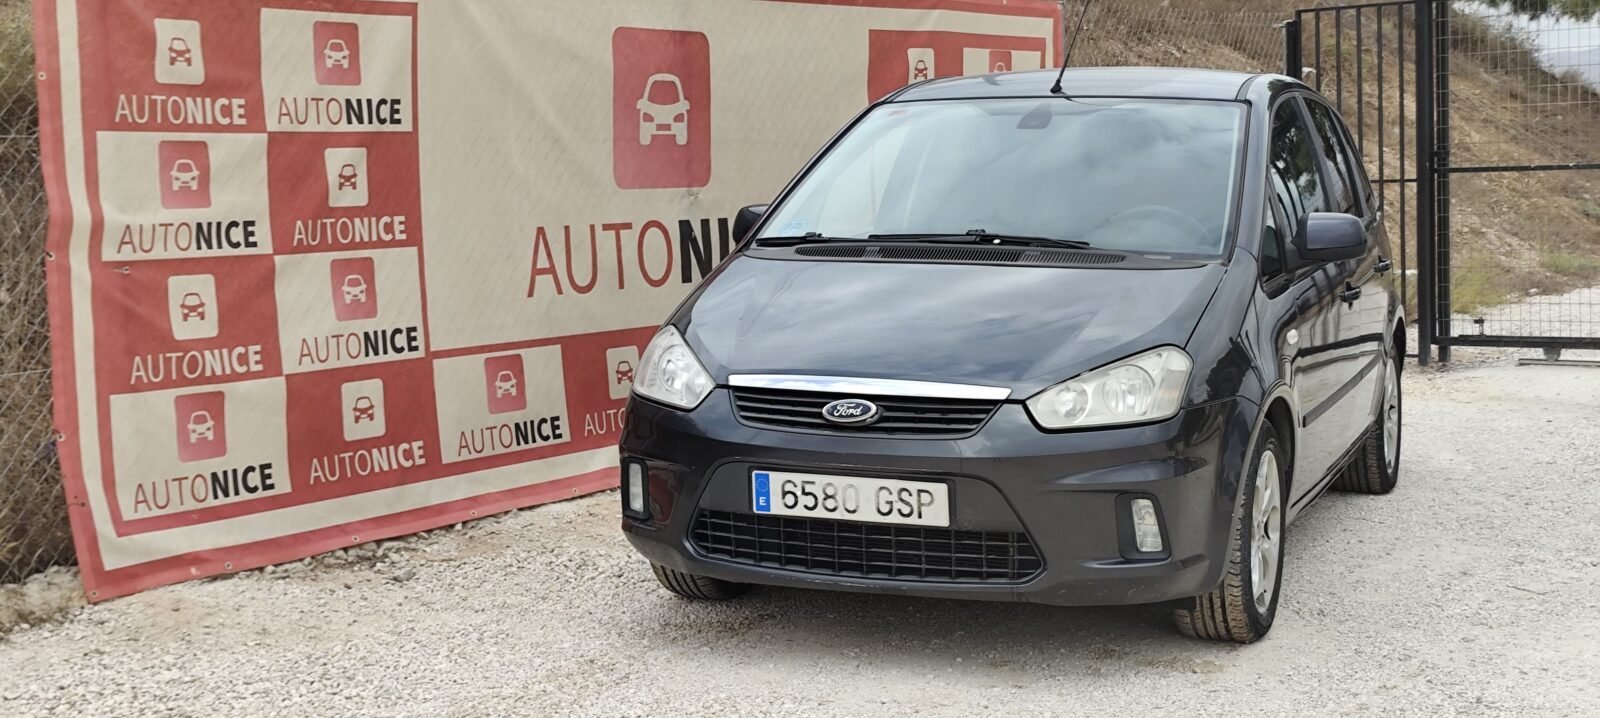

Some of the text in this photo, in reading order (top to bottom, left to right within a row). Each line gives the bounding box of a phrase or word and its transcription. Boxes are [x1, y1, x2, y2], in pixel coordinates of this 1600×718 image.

[115, 94, 247, 125] AUTONICE
[278, 97, 402, 125] AUTONICE
[117, 220, 258, 254] AUTONICE
[293, 215, 407, 246] AUTONICE
[527, 217, 730, 298] AUTONI
[131, 345, 263, 385] AUTONICE
[298, 326, 419, 366] AUTONICE
[833, 403, 863, 416] Ford
[458, 416, 563, 457] AUTONICE
[309, 440, 426, 485] AUTONICE
[134, 463, 275, 513] AUTONICE
[759, 479, 935, 519] E 6580 GSP
